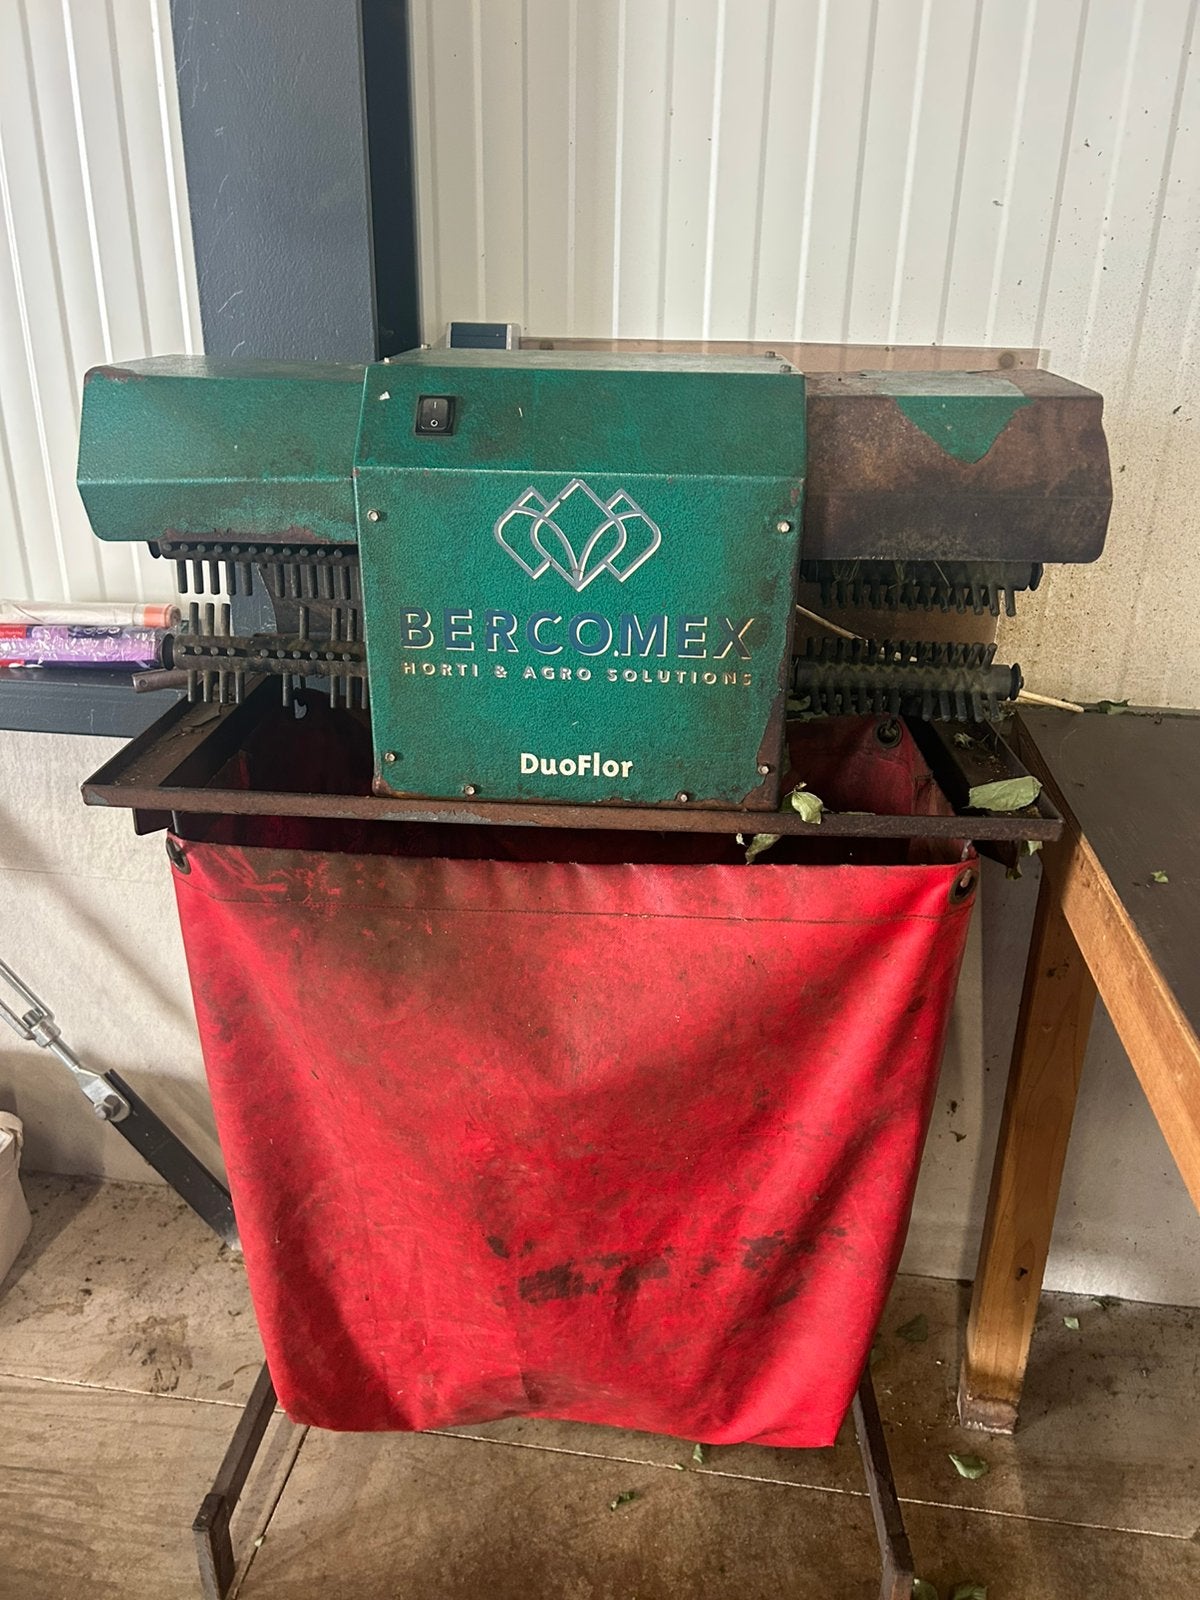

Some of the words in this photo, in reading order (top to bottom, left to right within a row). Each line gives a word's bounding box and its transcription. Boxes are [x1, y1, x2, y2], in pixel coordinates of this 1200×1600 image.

[403, 661, 479, 678] HORTI
[494, 665, 508, 679] &
[523, 666, 592, 681] AGRO
[607, 667, 752, 687] SOLUTIONS
[520, 752, 634, 778] DuoFlor
